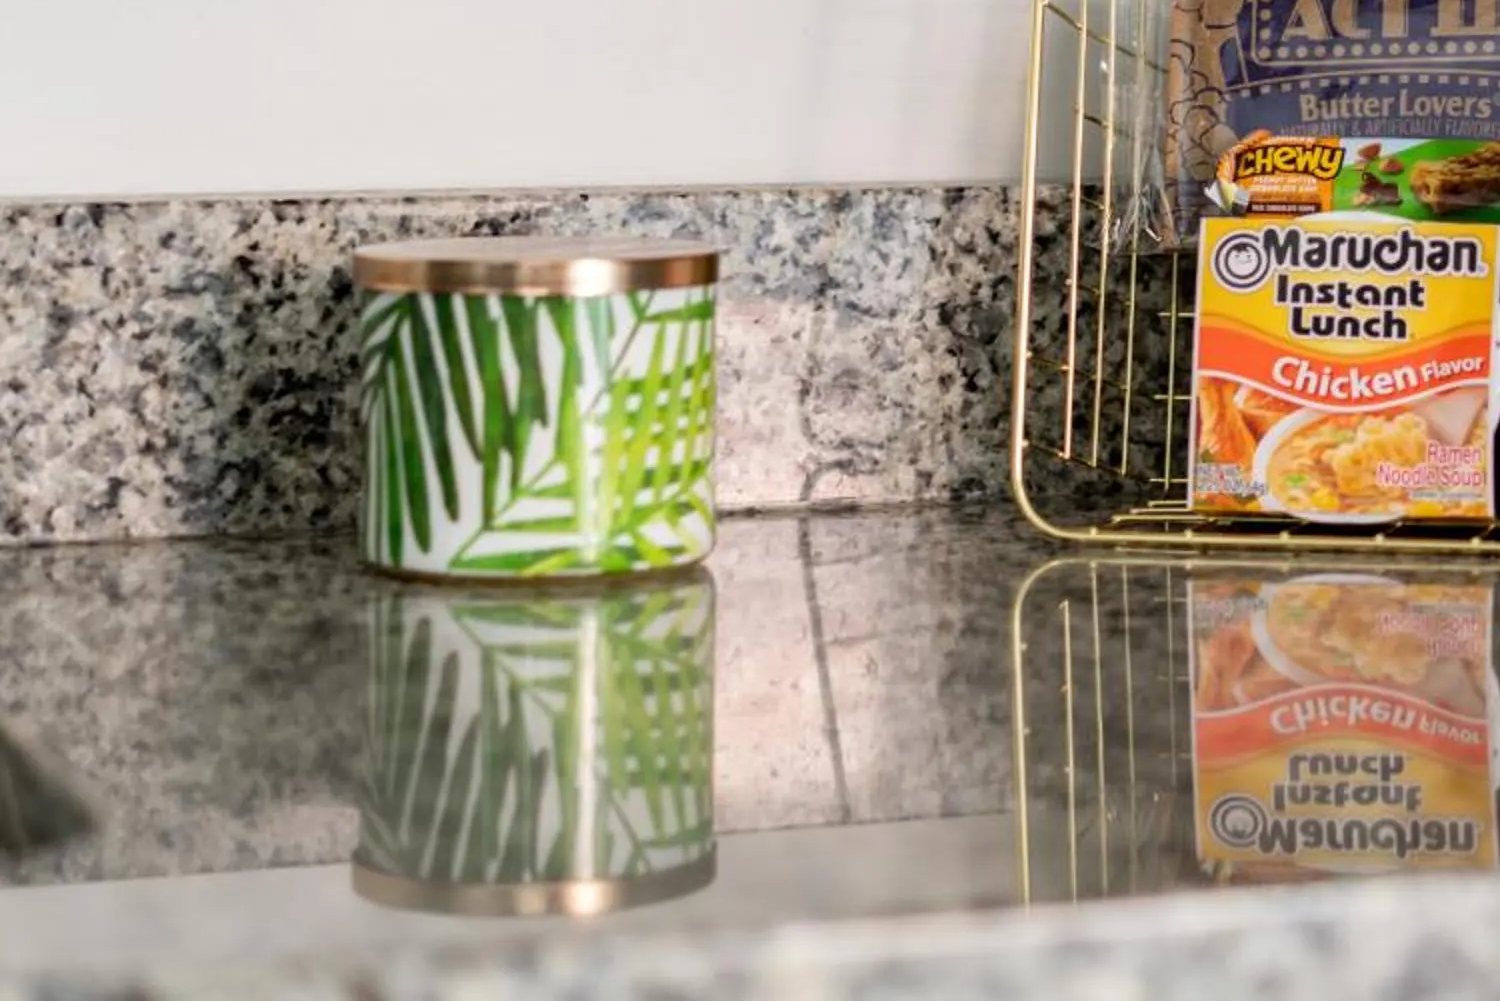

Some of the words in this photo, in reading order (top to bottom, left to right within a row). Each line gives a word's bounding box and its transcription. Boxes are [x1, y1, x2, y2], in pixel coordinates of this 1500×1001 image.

[1299, 93, 1395, 122] Butter
[1400, 89, 1493, 120] Lovers
[1263, 228, 1481, 274] Maruchan
[1276, 274, 1425, 309] Instant
[1291, 307, 1408, 339] Lunch
[1271, 355, 1418, 400] Chicken
[1420, 355, 1485, 384] Flavor
[1428, 441, 1482, 464] Ramen
[1378, 463, 1438, 486] Noodle
[1440, 464, 1482, 487] Soup
